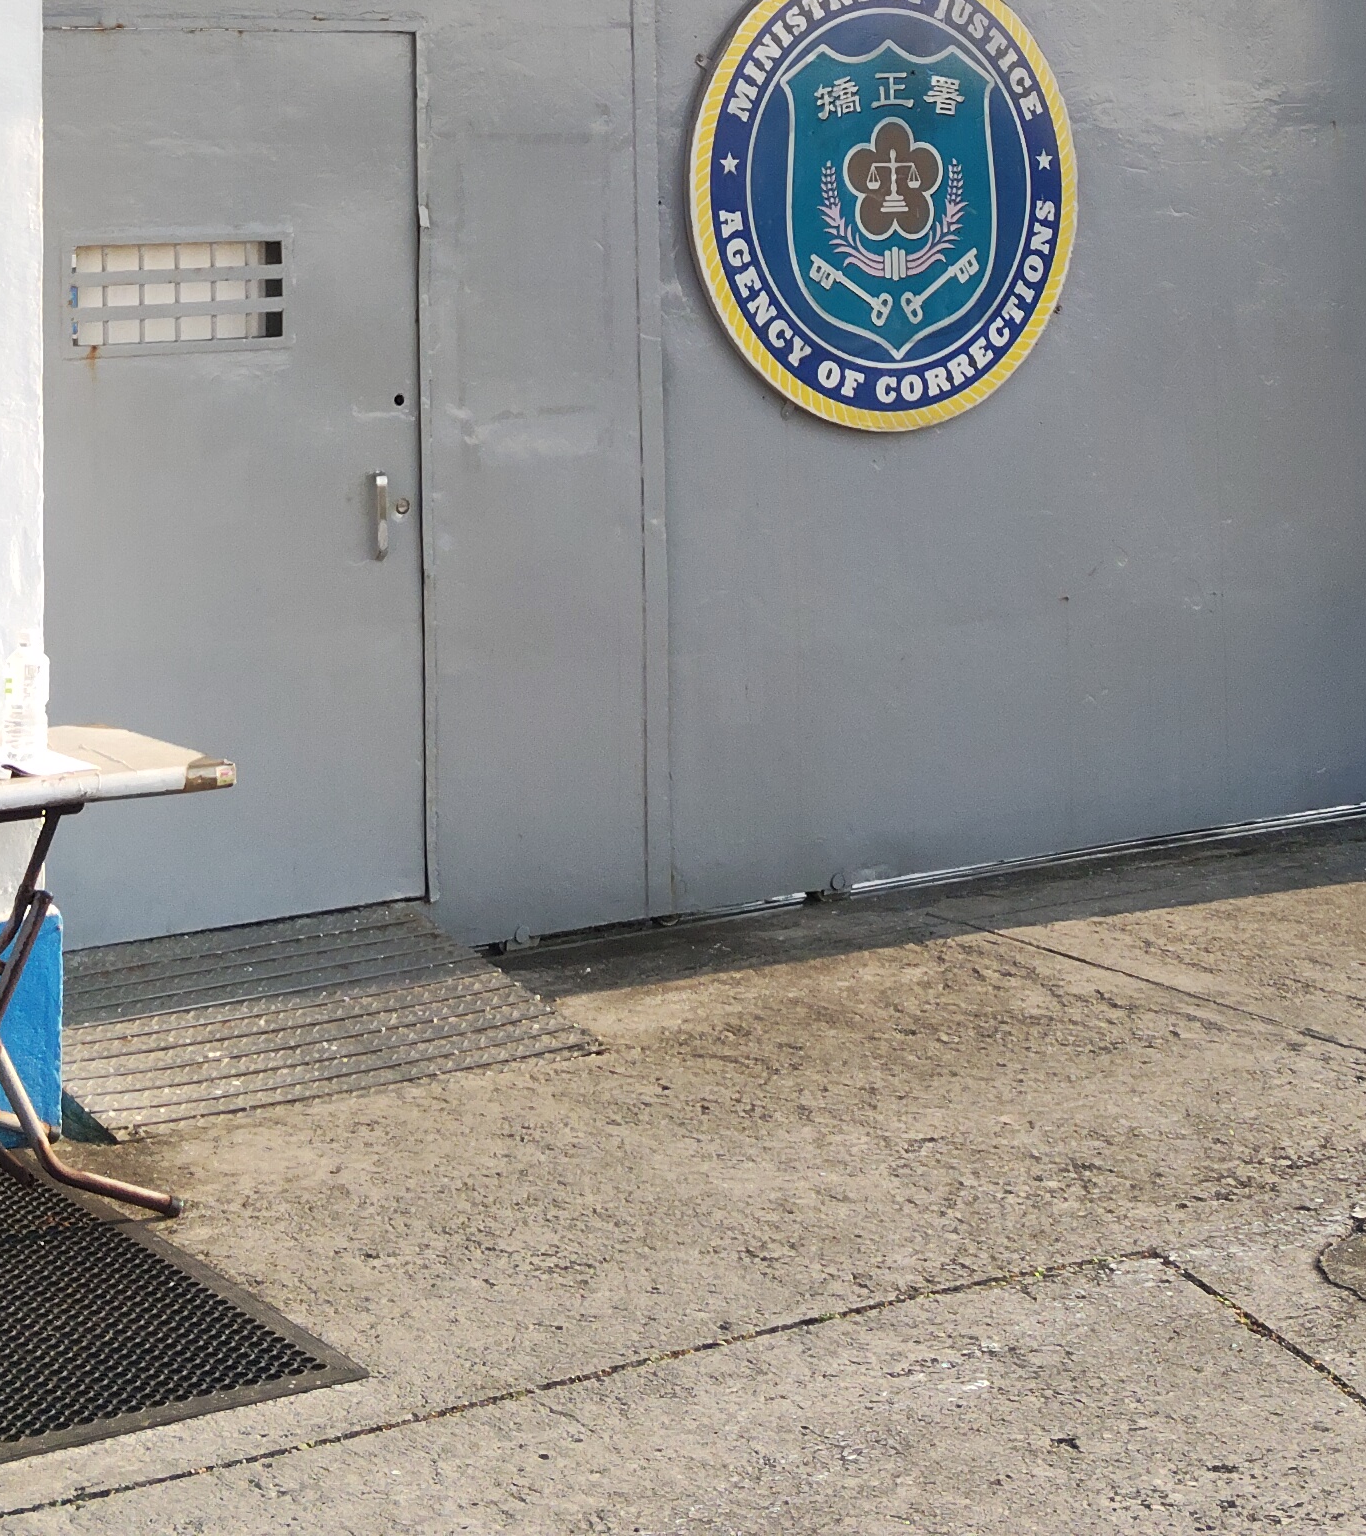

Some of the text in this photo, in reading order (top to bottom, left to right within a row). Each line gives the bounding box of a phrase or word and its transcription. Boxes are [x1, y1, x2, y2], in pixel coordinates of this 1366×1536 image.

[814, 71, 966, 121] 矯正署
[718, 198, 1056, 404] AGENCY OF CORRECTIONS
